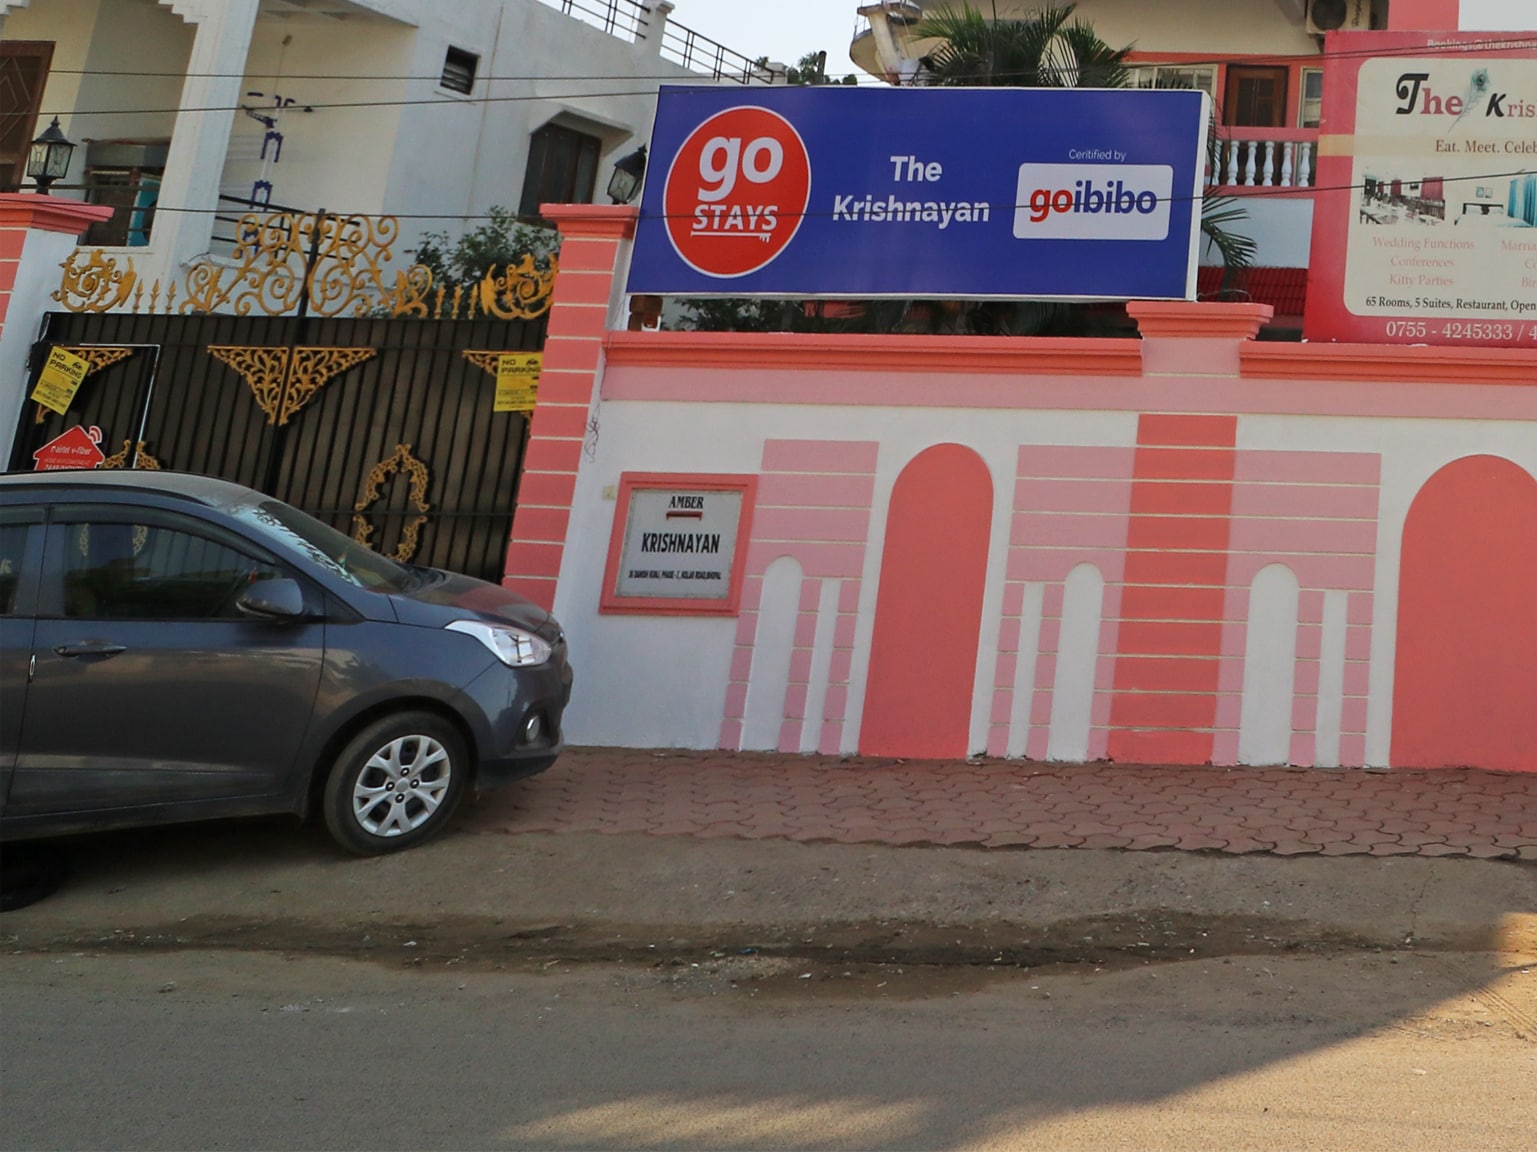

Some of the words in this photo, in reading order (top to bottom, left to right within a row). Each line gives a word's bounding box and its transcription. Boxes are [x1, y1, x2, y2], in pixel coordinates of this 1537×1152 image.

[1395, 73, 1464, 116] The
[1114, 149, 1127, 163] by
[1435, 139, 1460, 153] Eat.
[1464, 140, 1499, 154] Meet.
[697, 136, 784, 202] go
[889, 155, 943, 182] The
[1029, 179, 1158, 223] goibibo
[692, 204, 779, 231] STAYS
[832, 194, 990, 230] Krishnayan
[1373, 236, 1421, 252] Wedding
[1423, 238, 1475, 251] Functions
[1390, 256, 1455, 268] Conferences
[1389, 273, 1414, 287] Kitty
[1418, 274, 1454, 287] Parties
[1365, 296, 1377, 307] 65
[1378, 297, 1413, 309] Rooms,
[1414, 297, 1421, 308] 5
[1422, 298, 1454, 310] Suites,
[1456, 300, 1508, 312] Restaurant,
[1510, 300, 1537, 314] Open
[1385, 320, 1427, 338] 0755
[1441, 322, 1513, 341] 4245333
[52, 351, 66, 362] NO
[49, 358, 82, 379] PARKING
[668, 495, 705, 510] AMBER
[640, 532, 721, 554] KRISHNAYAN
